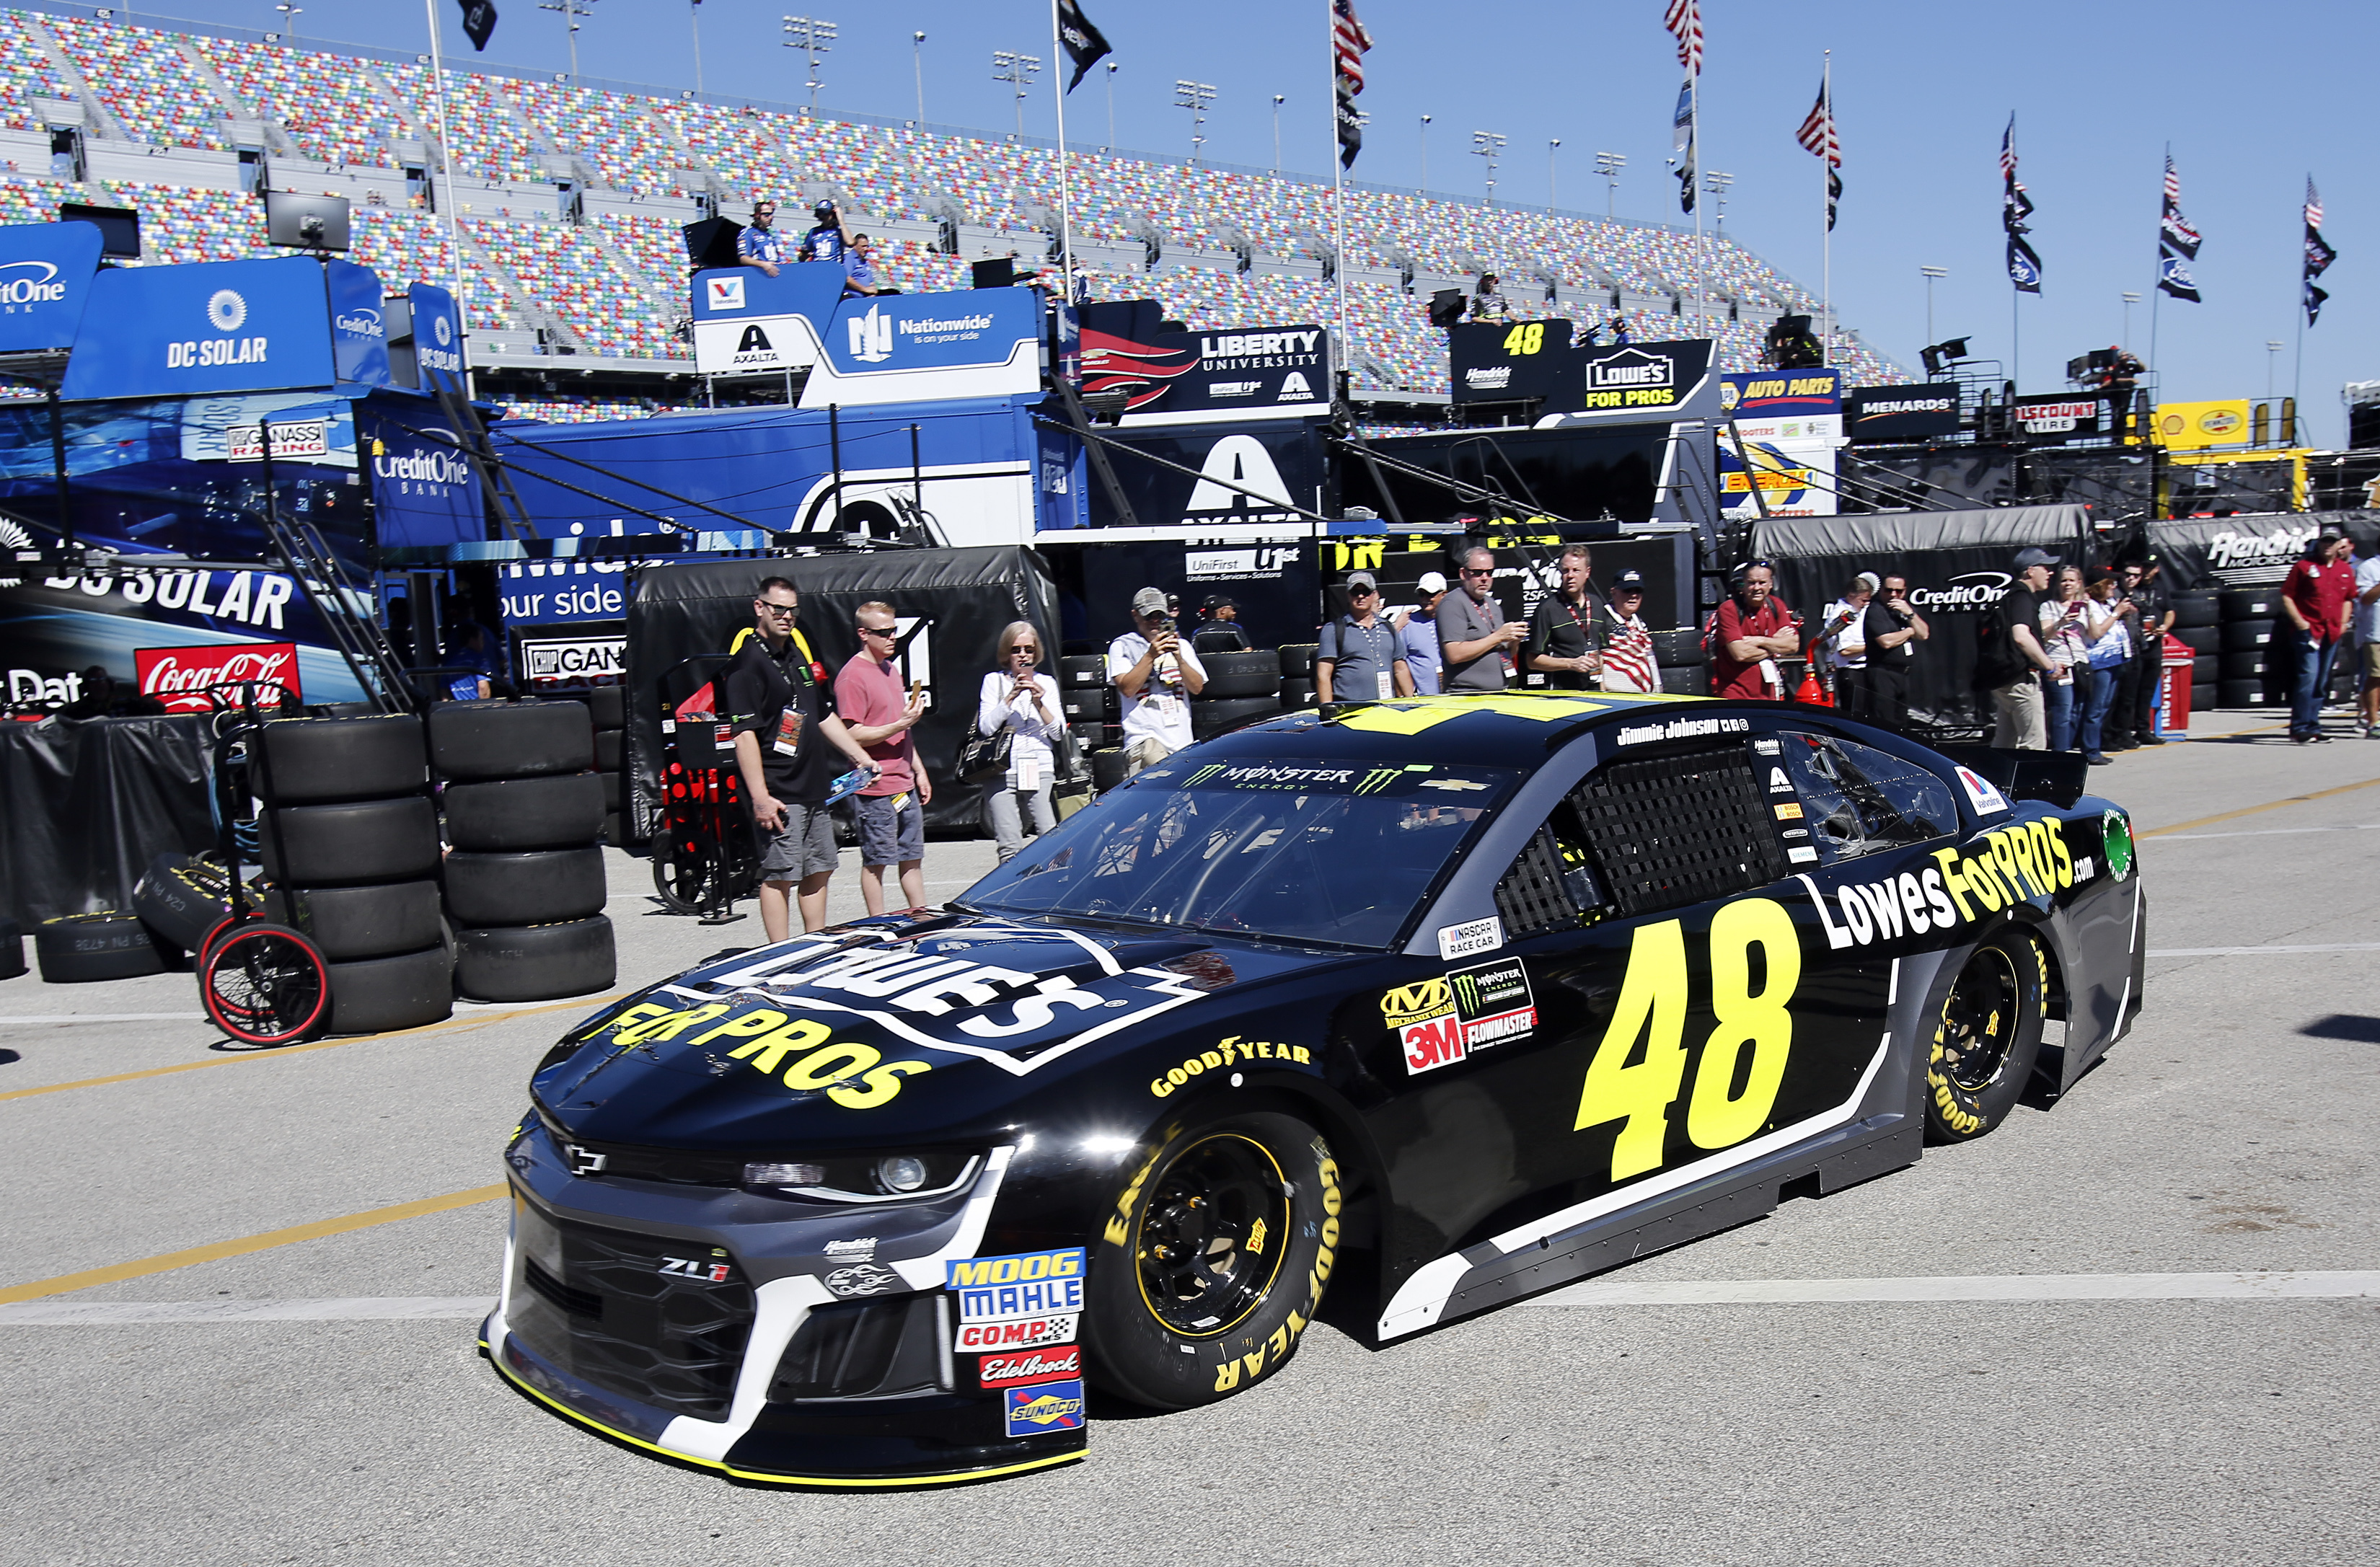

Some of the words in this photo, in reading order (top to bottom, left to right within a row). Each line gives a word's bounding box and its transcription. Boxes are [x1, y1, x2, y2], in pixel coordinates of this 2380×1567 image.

[899, 314, 991, 335] Nationwide
[914, 335, 922, 344] is
[938, 332, 958, 344] your
[960, 330, 979, 341] side
[1201, 330, 1320, 358] LIBERTY
[1503, 323, 1545, 356] 48
[167, 341, 197, 368] DC
[198, 337, 268, 366] SOLAR
[433, 349, 459, 372] SOLAR
[733, 353, 780, 363] AXALTA
[1202, 354, 1318, 371] UNIVERSITY
[1466, 366, 1512, 383] Hendrick
[1595, 362, 1667, 385] LOWE'S
[1277, 392, 1315, 402] AXALTA
[1587, 392, 1622, 407] FOR
[1626, 388, 1675, 406] PROS
[1742, 380, 1786, 399] AUTO
[1787, 376, 1835, 396] PARTS
[1862, 398, 1950, 414] MENARDS
[2032, 420, 2069, 431] TIRE
[401, 482, 450, 498] BANK
[1192, 560, 1240, 571] UniFirst
[555, 582, 623, 615] side
[1617, 724, 1665, 746] Jimmie
[1665, 718, 1719, 740] Johnson
[1755, 738, 1779, 751] Hendrick
[1770, 785, 1794, 794] AXALTA
[1975, 797, 2001, 809] Valvoline
[2103, 808, 2130, 838] AMERICAN
[1791, 849, 1815, 859] SIEMENS
[2108, 855, 2132, 883] ETHANOL
[1458, 922, 1492, 942] NASCAR
[1450, 939, 1473, 955] RACE
[1476, 936, 1494, 948] CAR
[1486, 981, 1517, 992] ENERGY
[1431, 1001, 1456, 1018] WEAR
[1467, 1011, 1533, 1053] FLOWMASTER
[1574, 897, 1802, 1183] 48
[1406, 1017, 1463, 1069] 3M
[580, 1003, 731, 1049] FOR
[687, 1009, 933, 1110] PROS
[658, 1257, 731, 1282] ZL1
[951, 1251, 1081, 1286] MOOG
[964, 1280, 1080, 1317] MAHLE
[964, 1321, 1046, 1346] COMP
[1021, 1333, 1062, 1346] CAMS
[980, 1351, 1080, 1382] Edelbrock
[1015, 1399, 1079, 1419] SUNOCO
